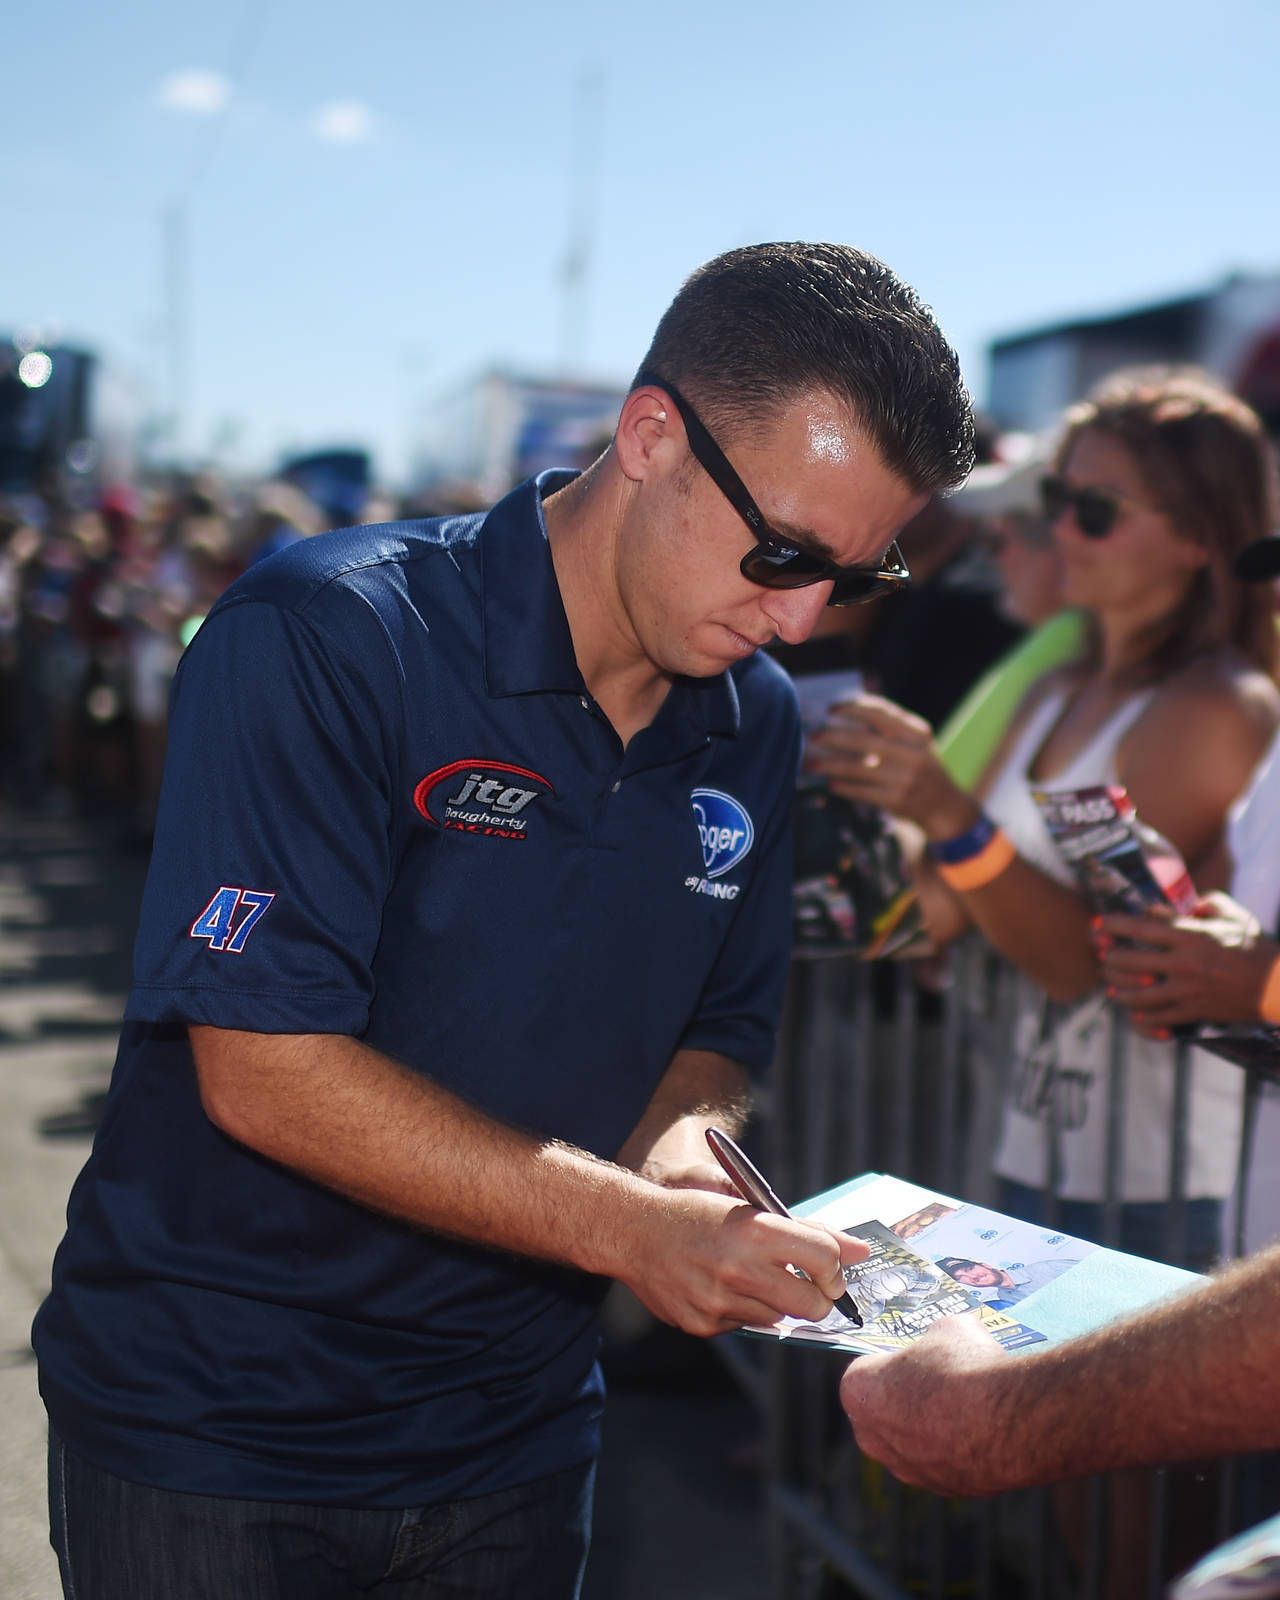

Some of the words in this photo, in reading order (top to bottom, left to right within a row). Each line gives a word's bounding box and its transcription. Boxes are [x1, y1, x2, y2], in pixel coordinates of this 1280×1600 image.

[447, 773, 539, 815] jtg
[445, 807, 527, 830] Daugherty
[190, 885, 277, 954] 47
